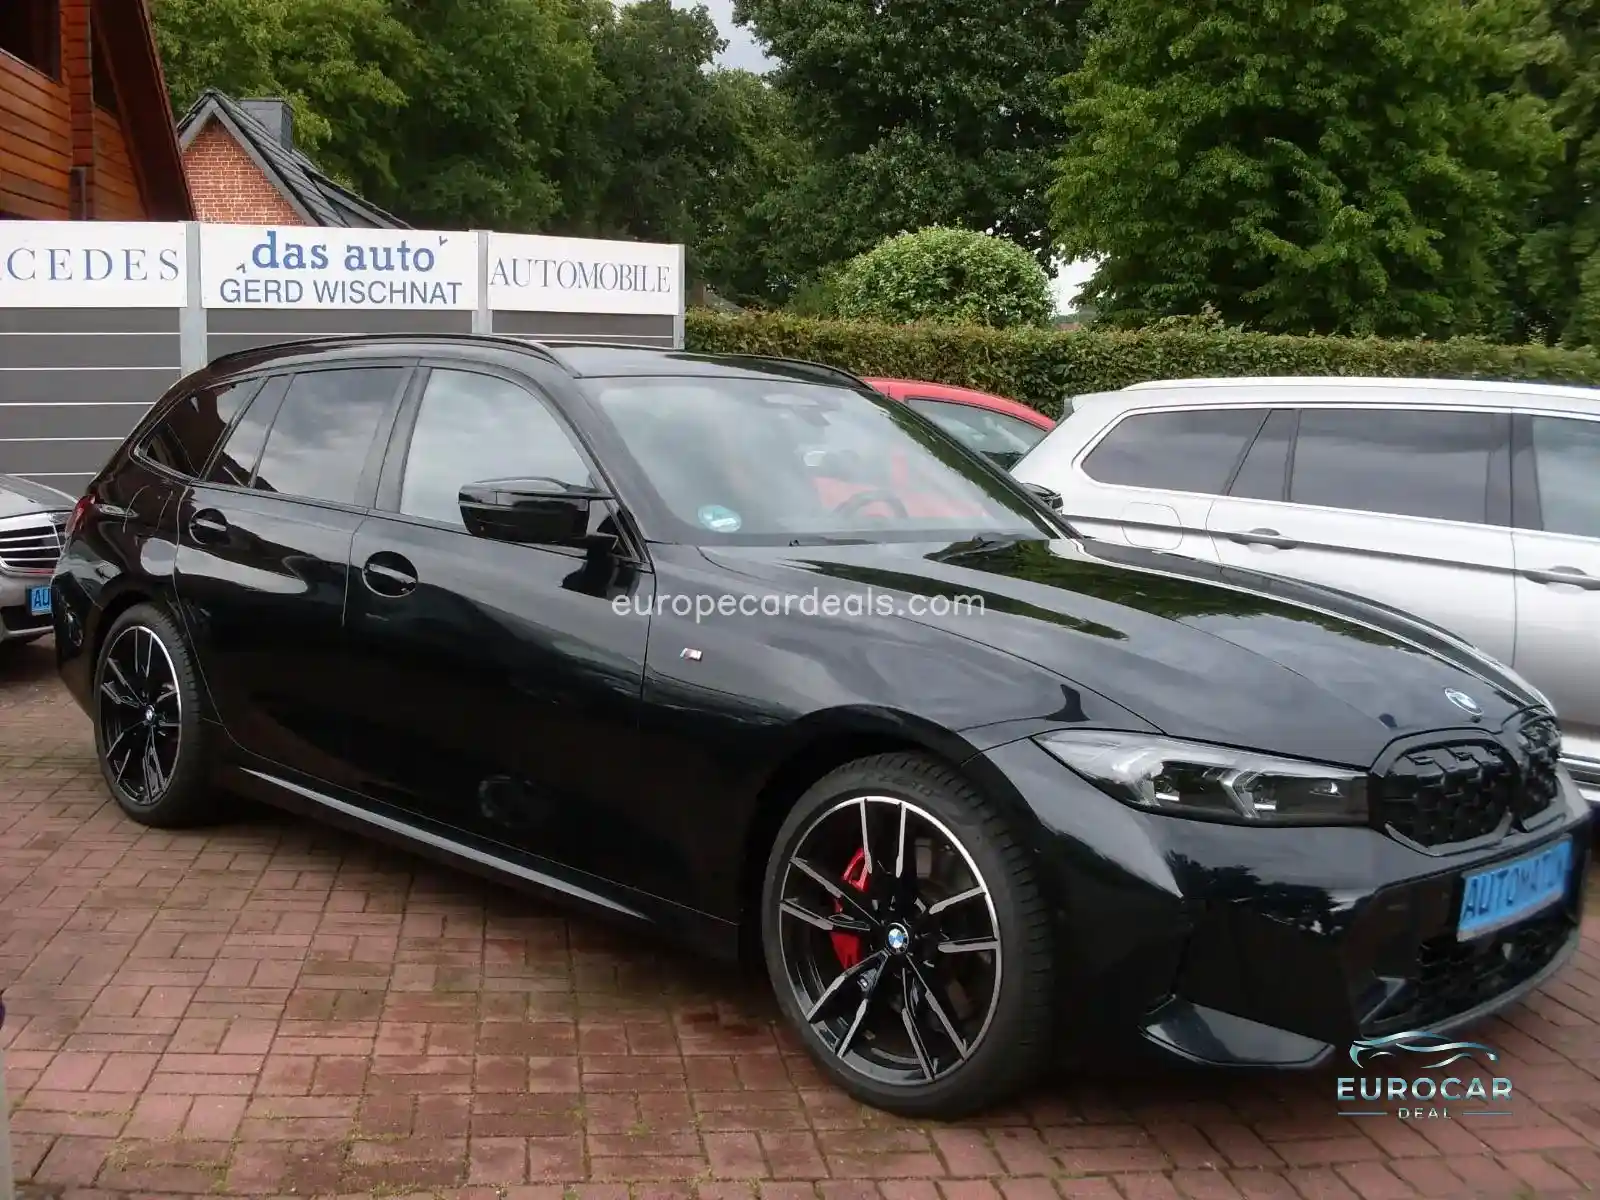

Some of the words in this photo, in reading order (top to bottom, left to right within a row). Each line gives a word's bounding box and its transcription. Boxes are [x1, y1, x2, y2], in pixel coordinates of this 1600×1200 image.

[0, 248, 179, 281] CEDES
[252, 230, 329, 269] das
[344, 240, 435, 272] auto
[220, 278, 303, 303] GERD
[313, 279, 462, 304] WISCHNAT
[489, 257, 671, 293] AUTOMOBILE
